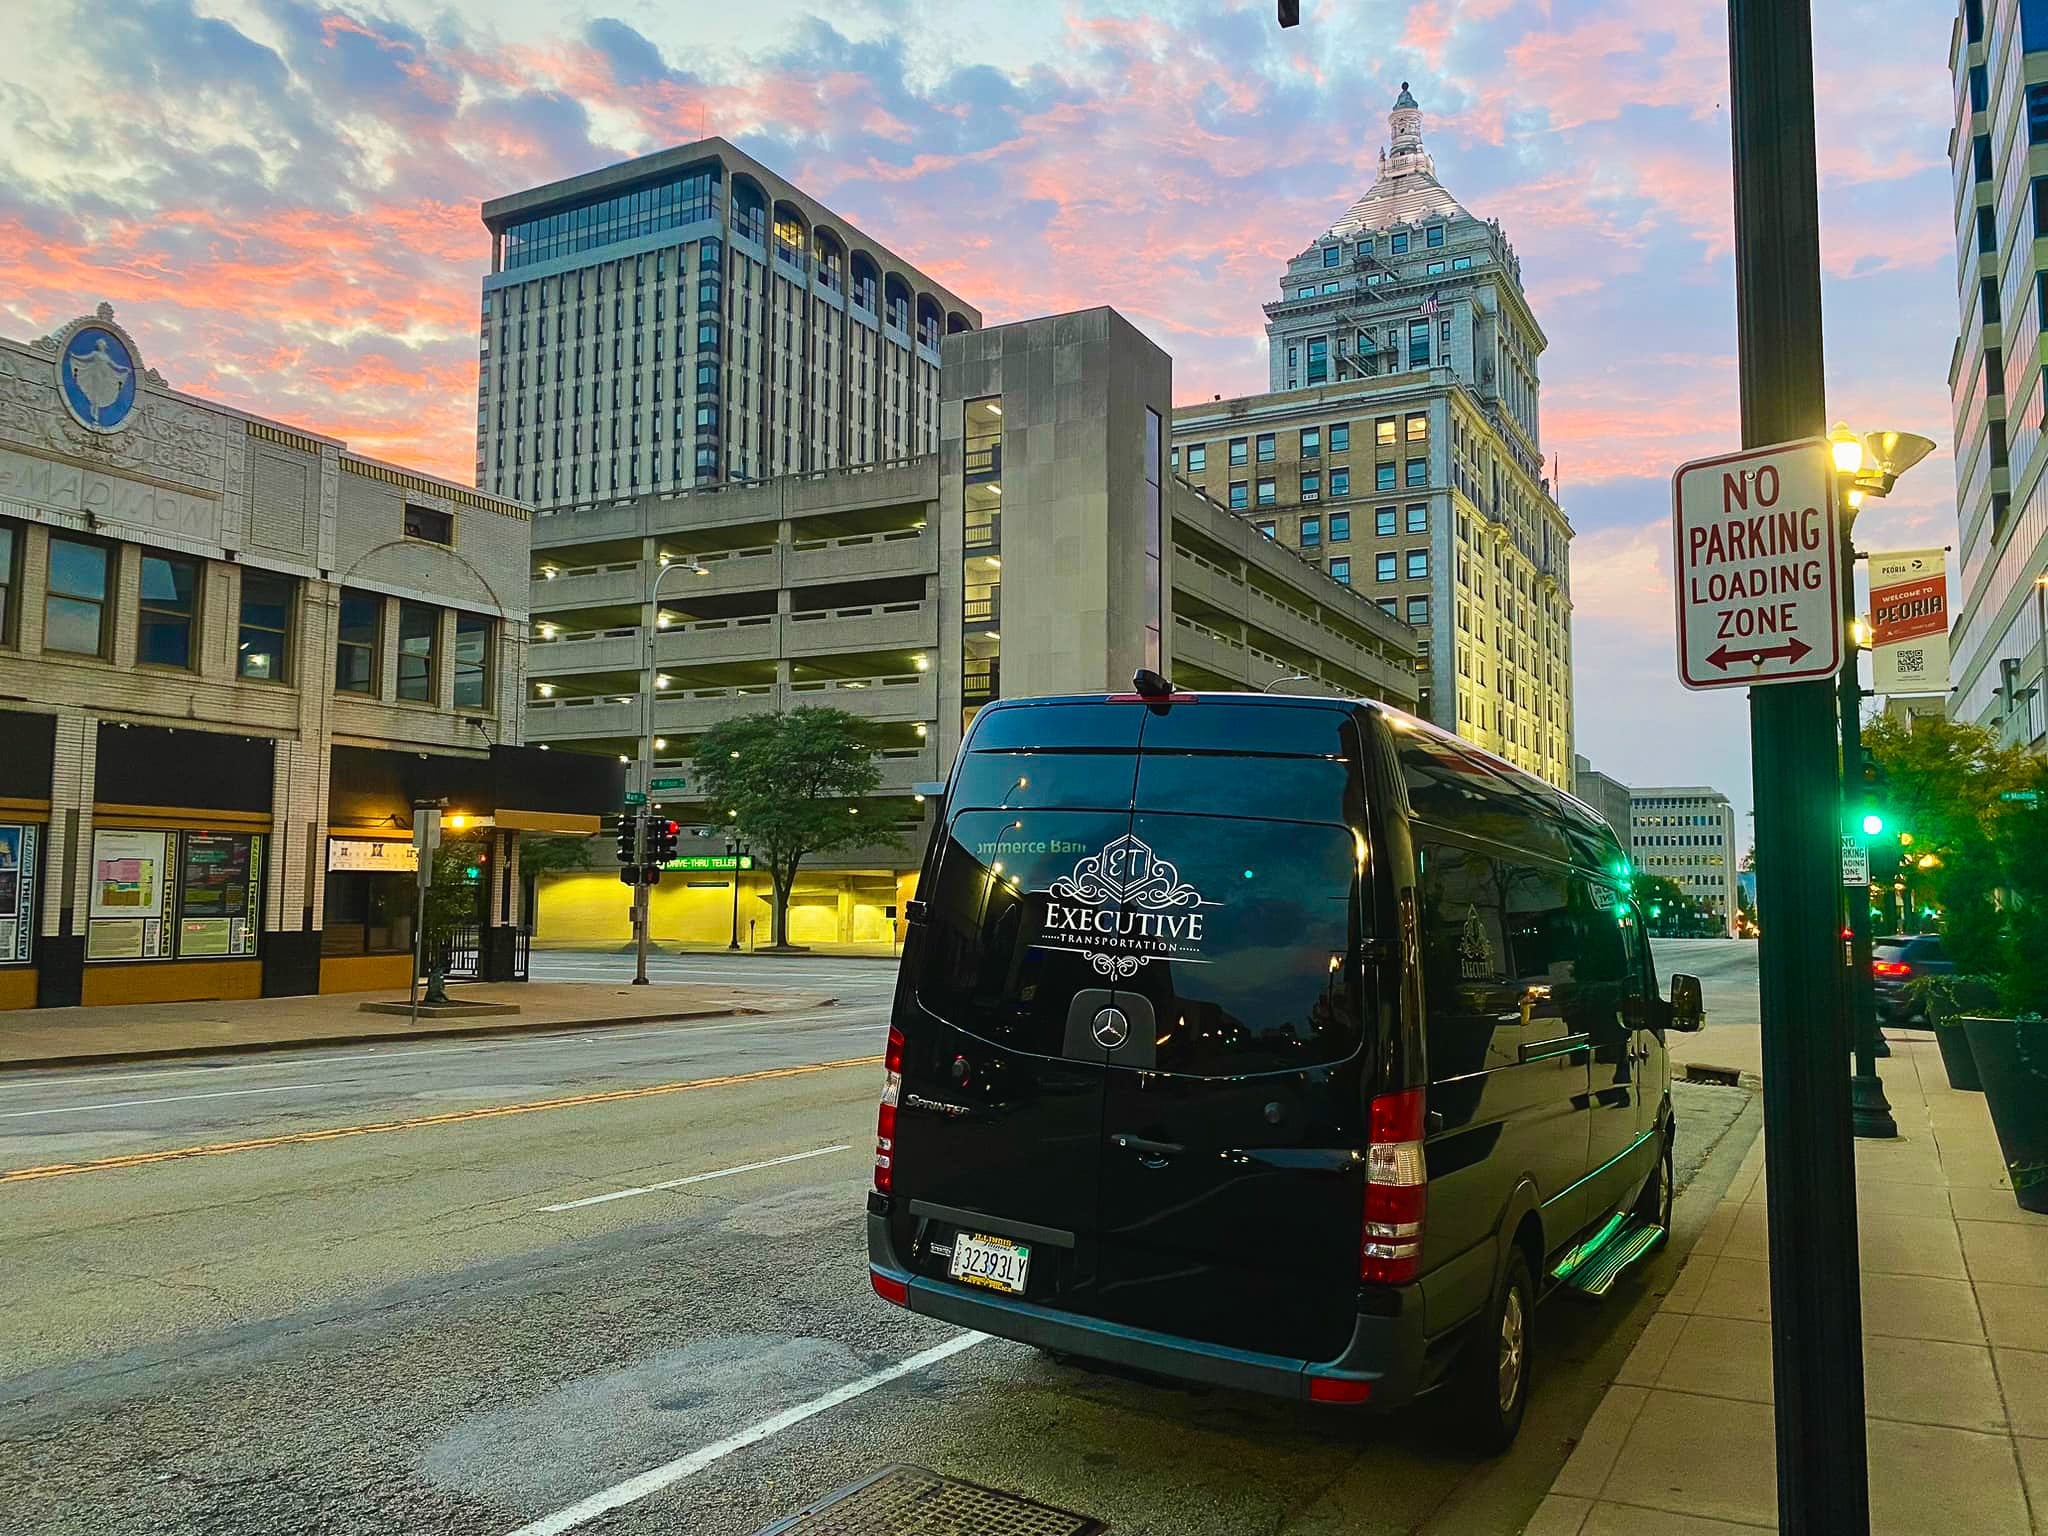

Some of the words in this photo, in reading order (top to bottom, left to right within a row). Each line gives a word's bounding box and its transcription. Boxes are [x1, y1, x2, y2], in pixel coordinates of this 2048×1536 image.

[1723, 465, 1780, 513] NO
[1690, 508, 1819, 567] PARKING
[1691, 561, 1821, 604] LOADING
[1882, 566, 1906, 574] PEORIA
[1877, 595, 1944, 626] PEORIA
[1882, 590, 1921, 603] WELCOME
[1717, 603, 1798, 639] ZONE
[711, 858, 737, 868] TELLER
[22, 881, 31, 903] THE
[164, 885, 172, 908] THE
[19, 905, 29, 957] PREVIEW
[162, 911, 171, 953] PLANS
[1044, 902, 1204, 940] EXECUTIVE
[1060, 933, 1178, 952] TRANSPORTATION
[962, 1247, 1026, 1282] 32393LY
